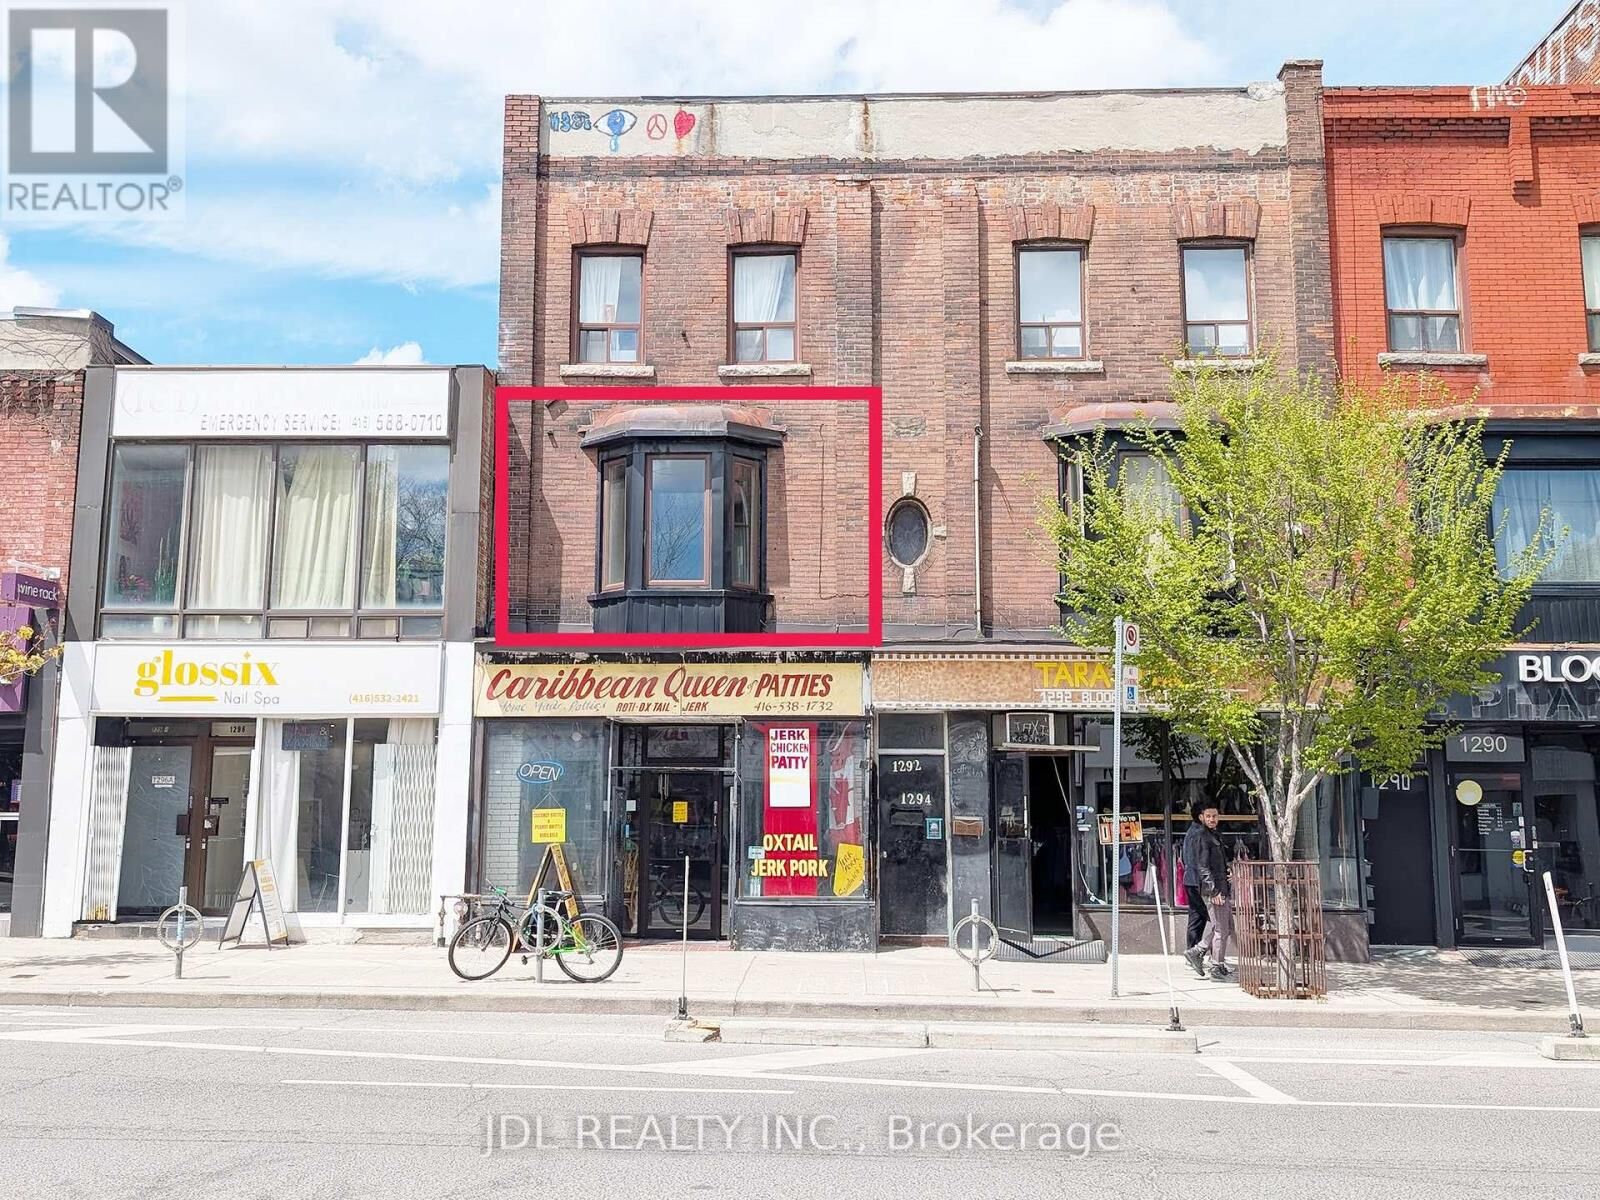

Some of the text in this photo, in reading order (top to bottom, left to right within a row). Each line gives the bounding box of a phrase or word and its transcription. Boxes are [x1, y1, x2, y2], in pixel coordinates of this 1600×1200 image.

[201, 414, 278, 431] EMERGENCY
[376, 414, 442, 431] 588-0710
[18, 582, 58, 601] wine rack
[134, 650, 280, 696] glossix
[1034, 662, 1112, 688] TARA
[1518, 655, 1600, 682] BLO
[486, 668, 659, 700] Caribbean
[664, 666, 748, 702] Queen
[754, 674, 833, 698] PATTIES
[223, 691, 280, 708] Nail Spa
[1039, 691, 1072, 703] 1292
[682, 702, 709, 712] JERK
[754, 702, 834, 712] 416-538-1732
[770, 730, 805, 741] JERK
[1459, 736, 1507, 752] 1290
[770, 743, 809, 753] CHICKEN
[771, 756, 808, 769] PATTY
[892, 760, 922, 773] 1292
[520, 763, 561, 781] OPEN
[901, 793, 932, 806] 1294
[763, 834, 818, 852] OXTAIL
[751, 860, 828, 877] JERK PORK
